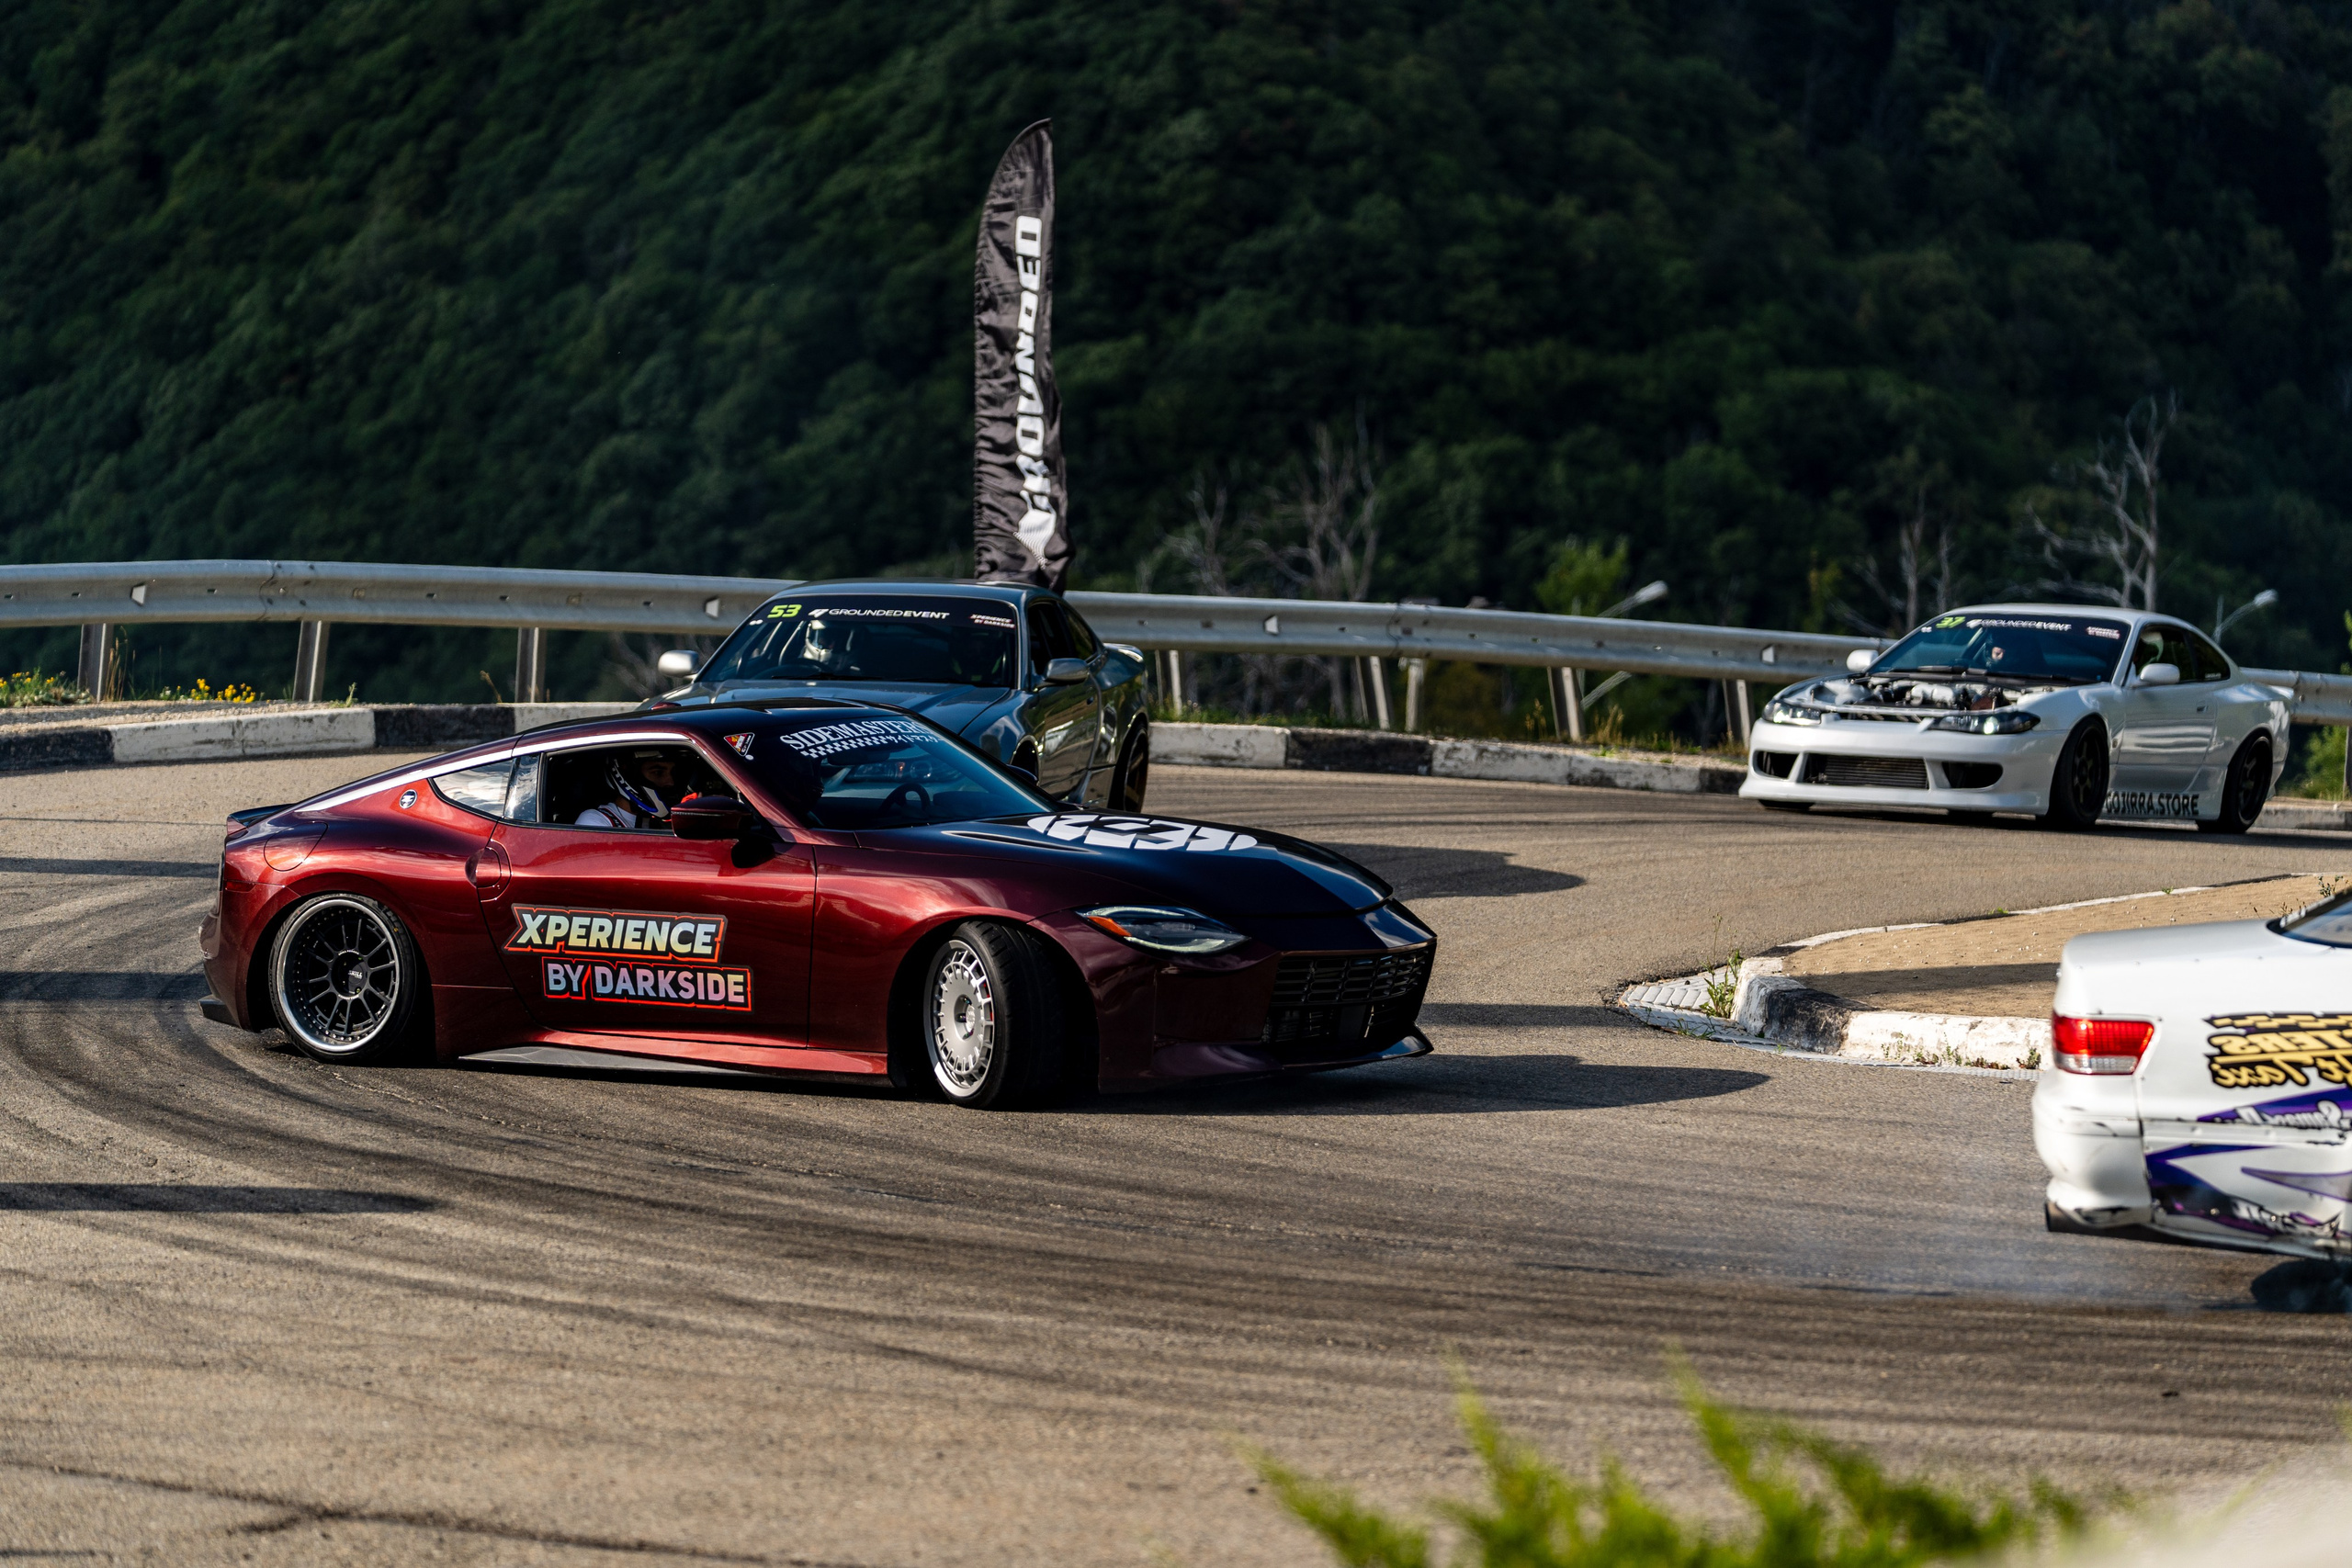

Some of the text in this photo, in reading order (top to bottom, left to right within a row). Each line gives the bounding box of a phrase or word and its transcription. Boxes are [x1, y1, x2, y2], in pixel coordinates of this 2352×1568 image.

[1015, 215, 1057, 514] GROUNDED
[767, 604, 802, 618] 53
[1936, 616, 1966, 628] 37
[2106, 791, 2199, 816] GOJIRRA.STORE
[516, 913, 717, 954] XPERIENCE
[548, 963, 745, 1003] BY DARKSIDE
